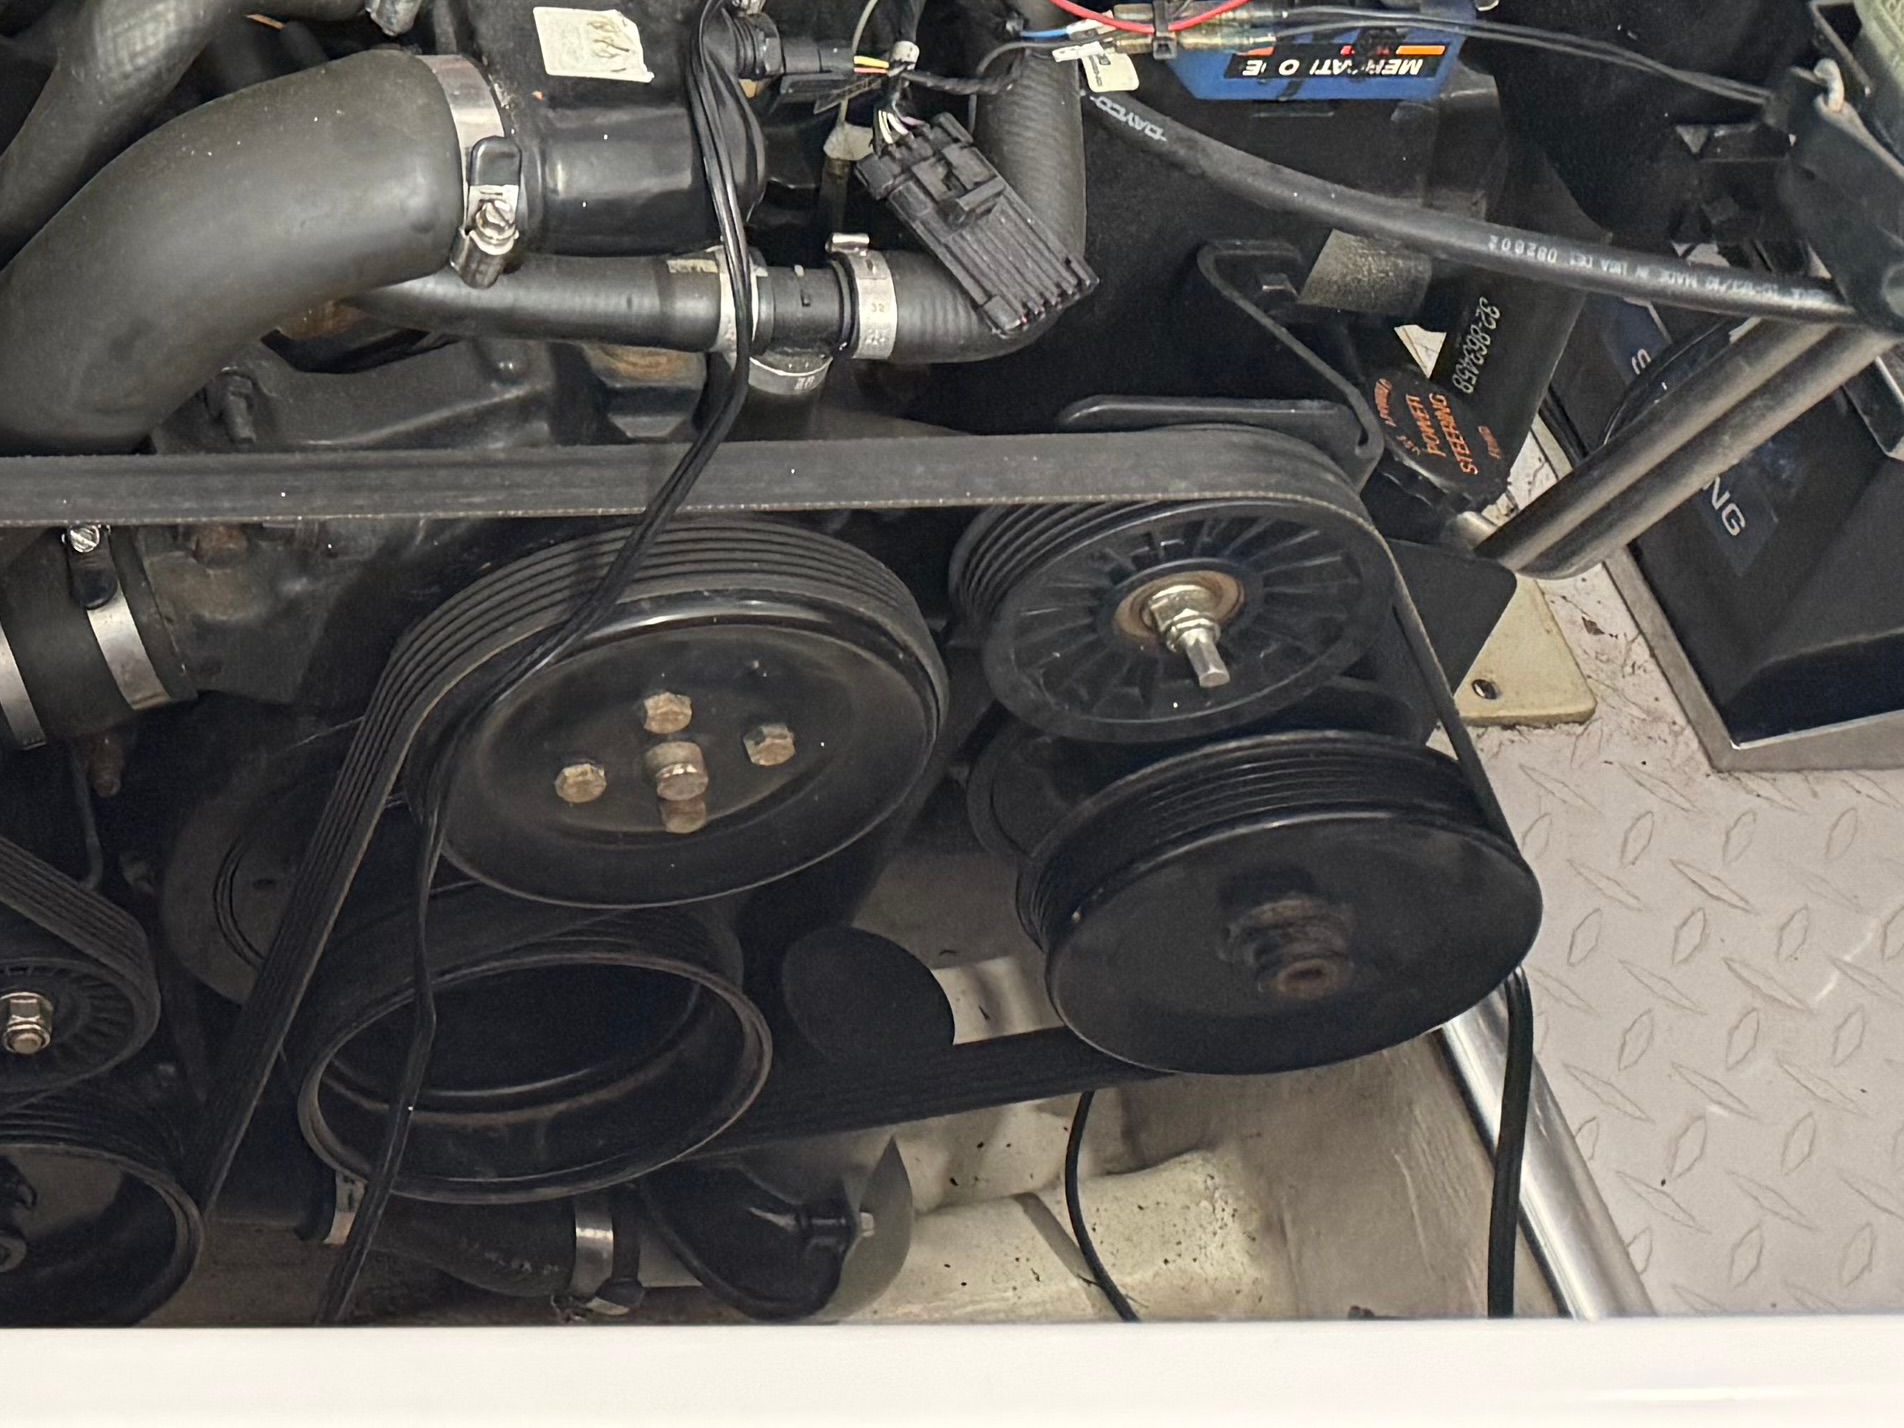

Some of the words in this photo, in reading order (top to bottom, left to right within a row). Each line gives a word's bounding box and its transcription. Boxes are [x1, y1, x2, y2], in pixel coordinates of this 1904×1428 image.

[1093, 95, 1165, 140] DAYCO
[1406, 394, 1447, 457] POWER
[1429, 393, 1478, 475] STEERING
